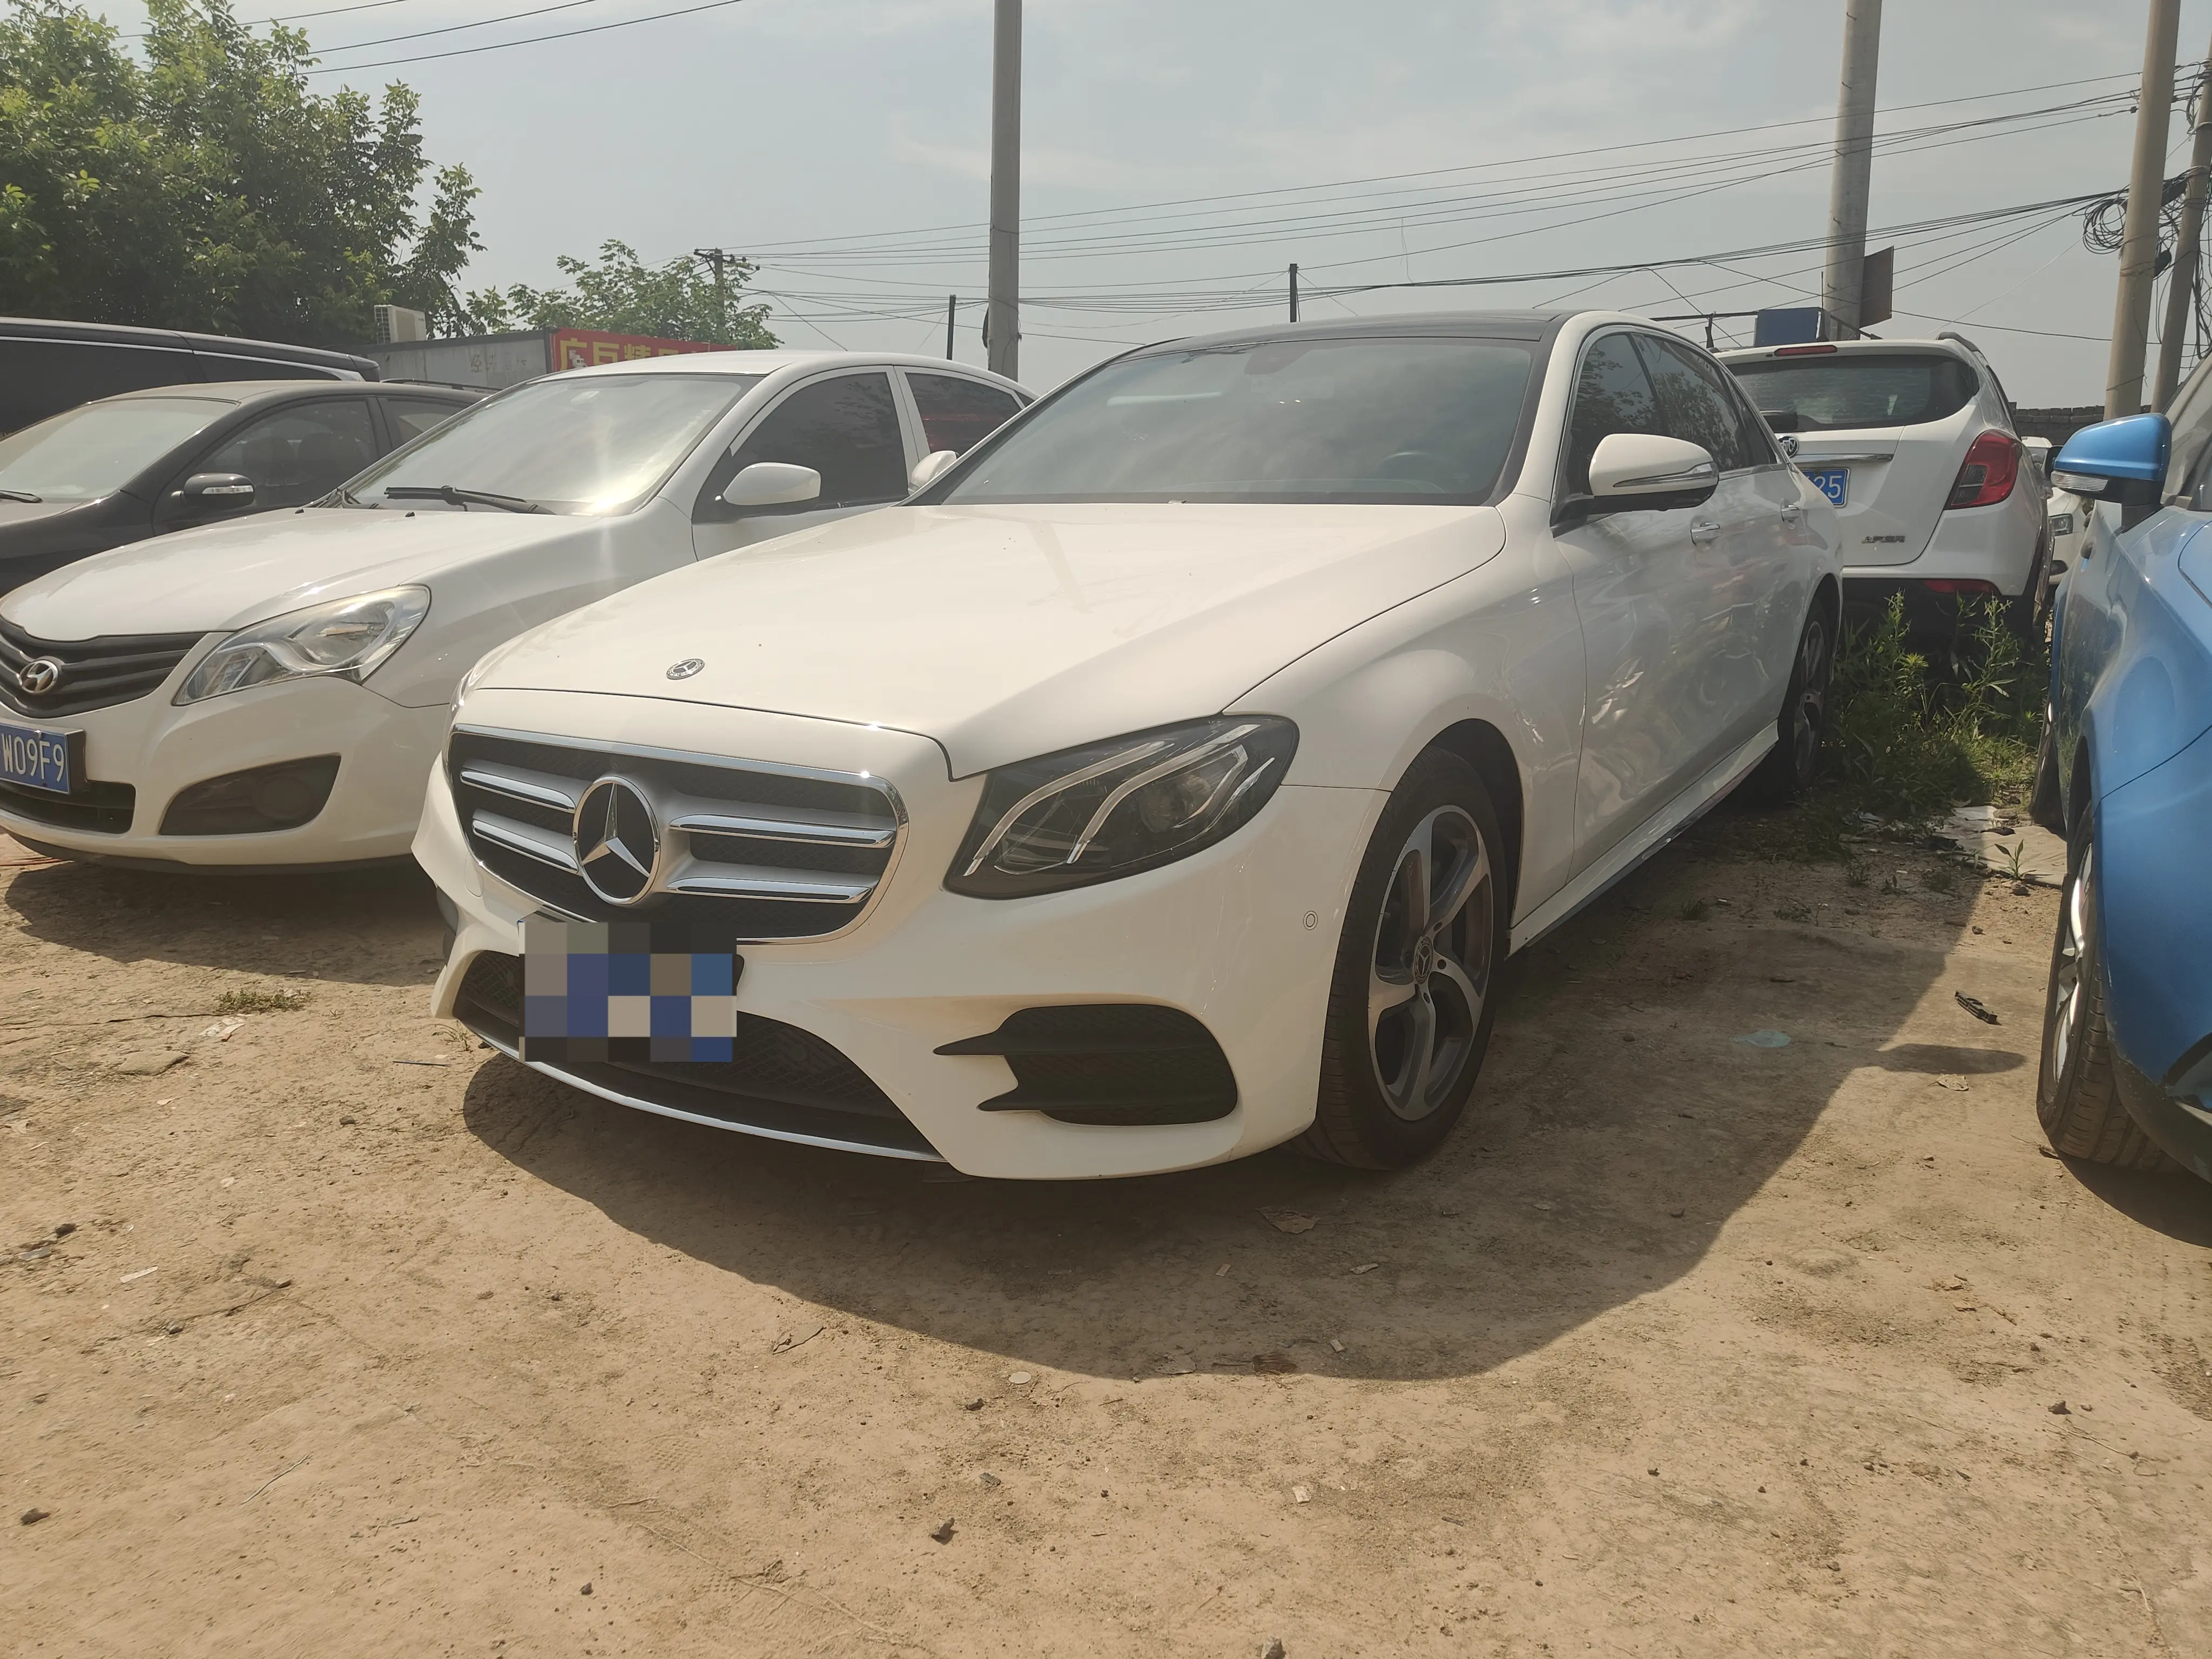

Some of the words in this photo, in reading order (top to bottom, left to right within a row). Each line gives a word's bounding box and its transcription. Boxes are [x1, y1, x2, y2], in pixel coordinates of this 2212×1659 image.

[560, 338, 679, 371] 广巨精
[1806, 475, 1843, 499] 25
[2, 733, 65, 783] W09F9
